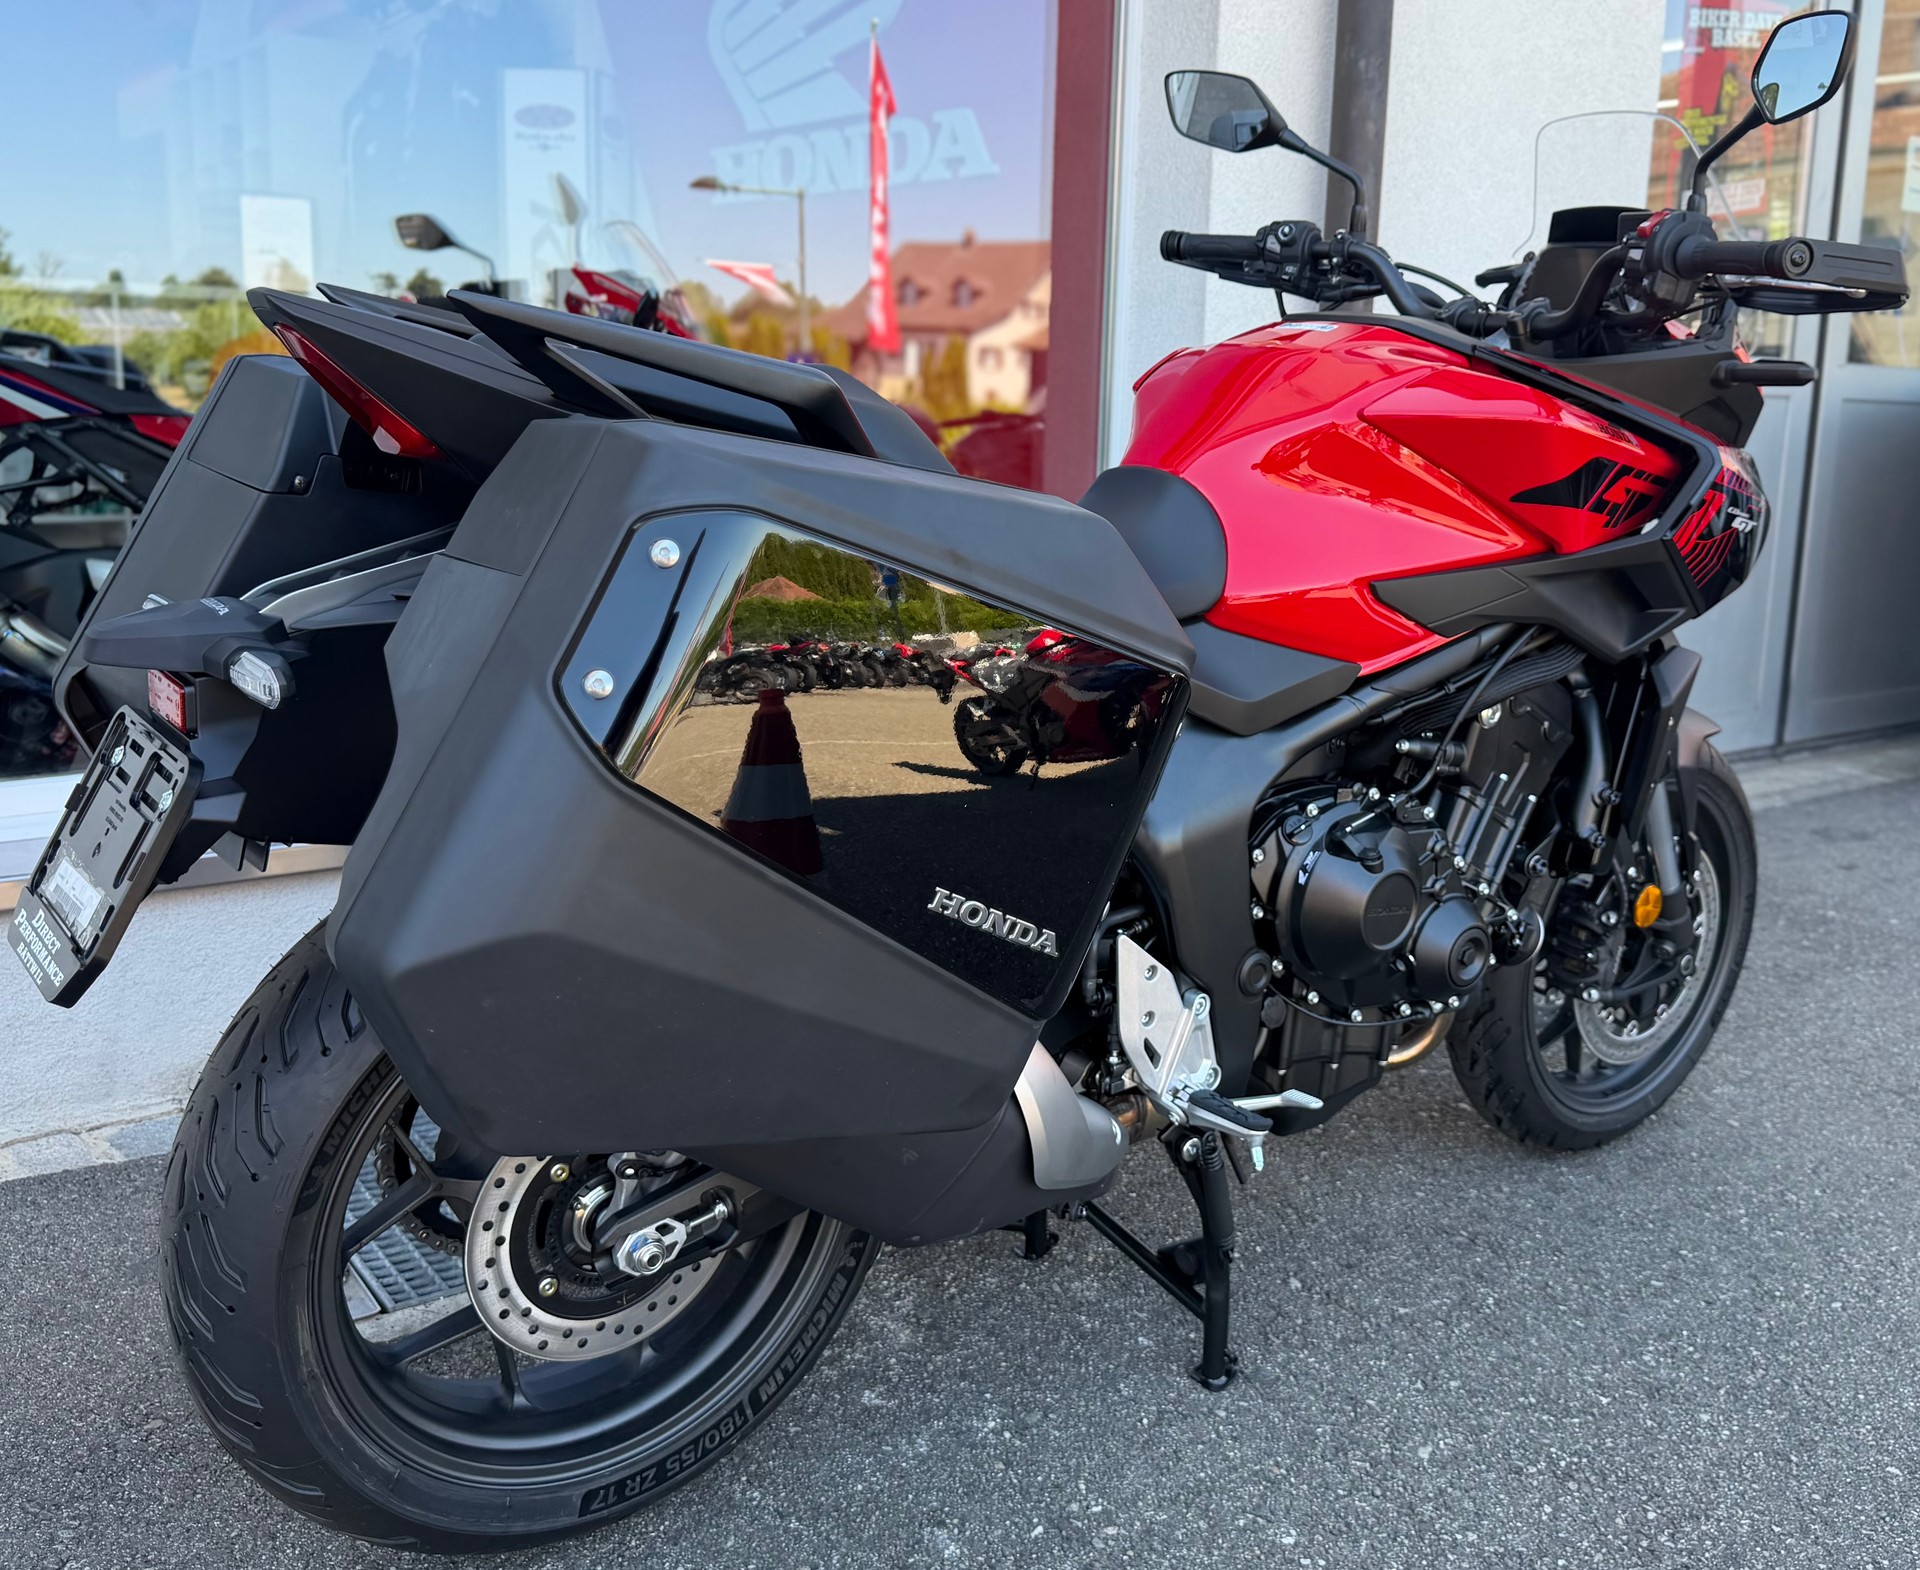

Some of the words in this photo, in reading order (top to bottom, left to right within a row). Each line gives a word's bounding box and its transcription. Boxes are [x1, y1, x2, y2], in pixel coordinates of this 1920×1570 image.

[1689, 8, 1740, 28] BIKER
[1711, 28, 1762, 48] BASEL
[1731, 516, 1757, 533] GT
[31, 908, 62, 955] DIRECT
[927, 886, 1059, 958] HONDA
[14, 908, 65, 988] PERFORMANCE
[323, 1055, 394, 1156] MICHE
[758, 1272, 848, 1402] MICHELIN
[666, 1410, 745, 1477] 180/55
[590, 1486, 618, 1510] 17
[624, 1467, 657, 1496] ZR
